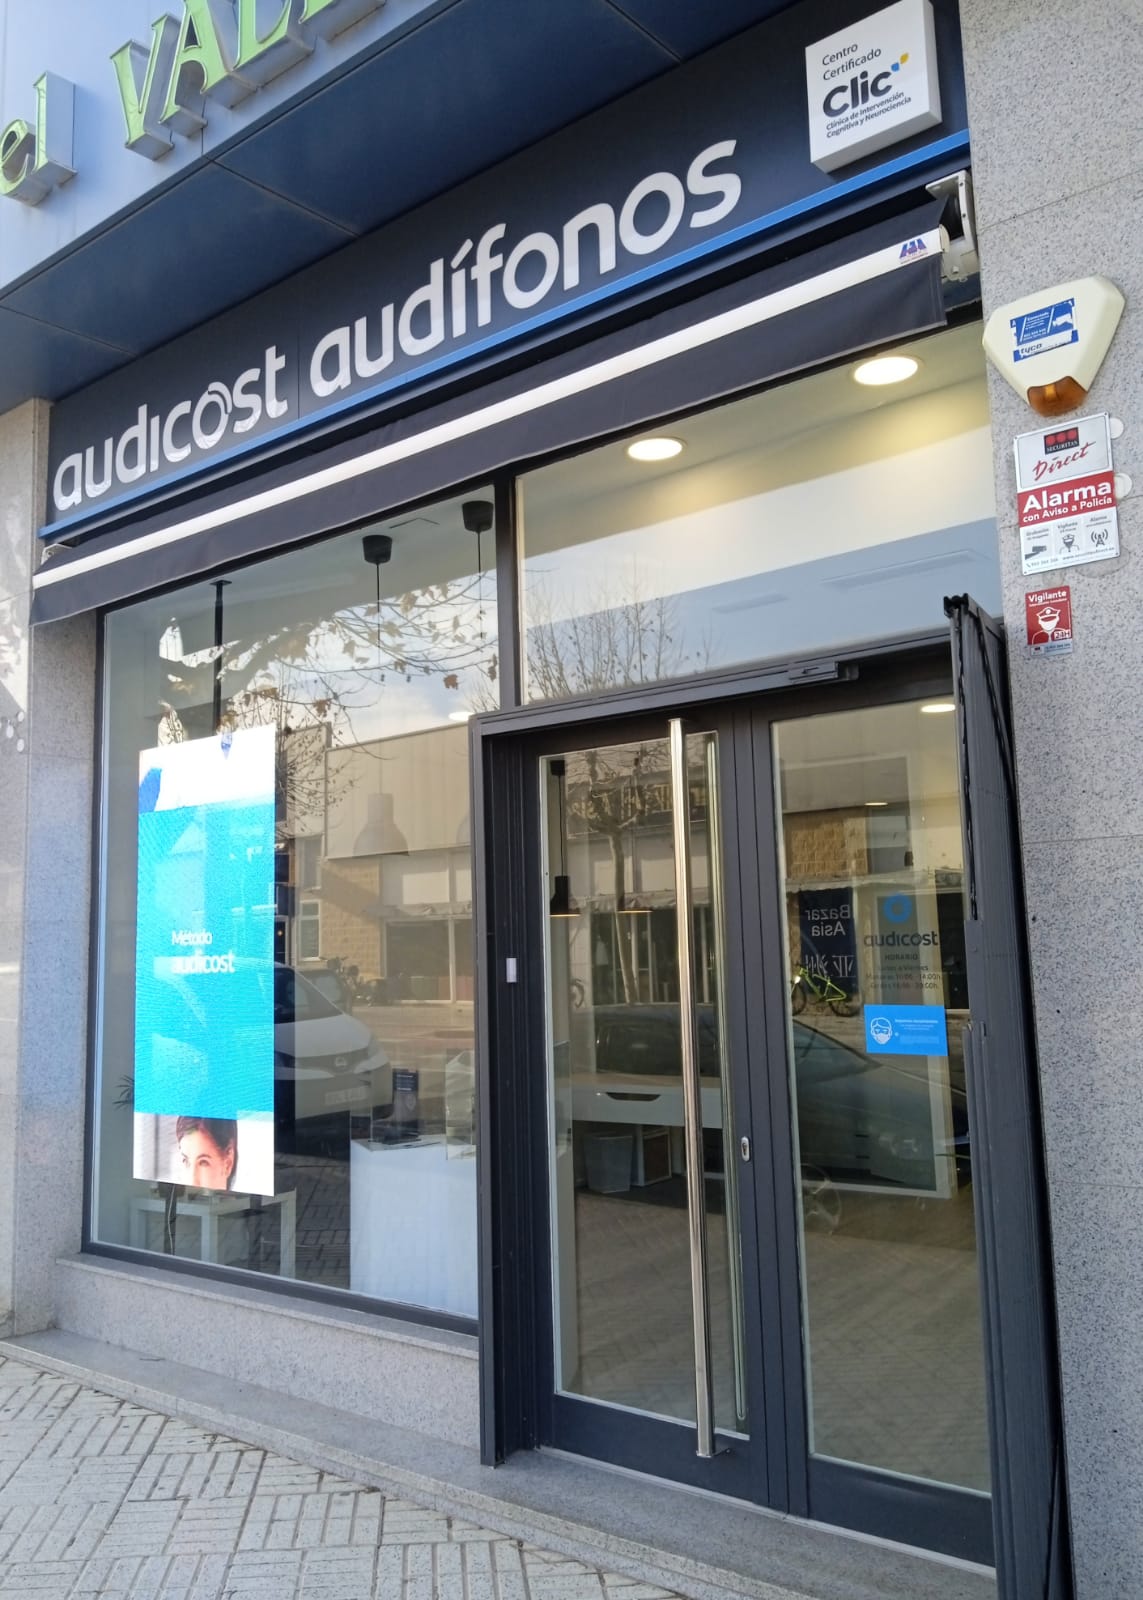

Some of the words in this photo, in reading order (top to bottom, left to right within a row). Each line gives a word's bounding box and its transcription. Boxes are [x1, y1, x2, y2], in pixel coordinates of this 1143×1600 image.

[822, 44, 858, 66] Centro
[823, 48, 881, 81] Certificado
[111, 0, 334, 150] VAL
[822, 70, 892, 117] Clic
[826, 120, 859, 138] Cognitiva
[860, 118, 865, 126] y
[865, 97, 911, 121] Neurociencia
[850, 112, 859, 120] de
[52, 345, 288, 511] audicost
[310, 139, 742, 397] audífonos
[1020, 343, 1043, 354] tyco
[1032, 441, 1096, 481] Direct
[1023, 482, 1111, 513] Alarma
[1023, 513, 1040, 522] con
[1042, 506, 1068, 518] Aviso
[1080, 496, 1112, 509] Policía
[1028, 591, 1067, 603] Vigilante
[863, 931, 939, 948] audicost
